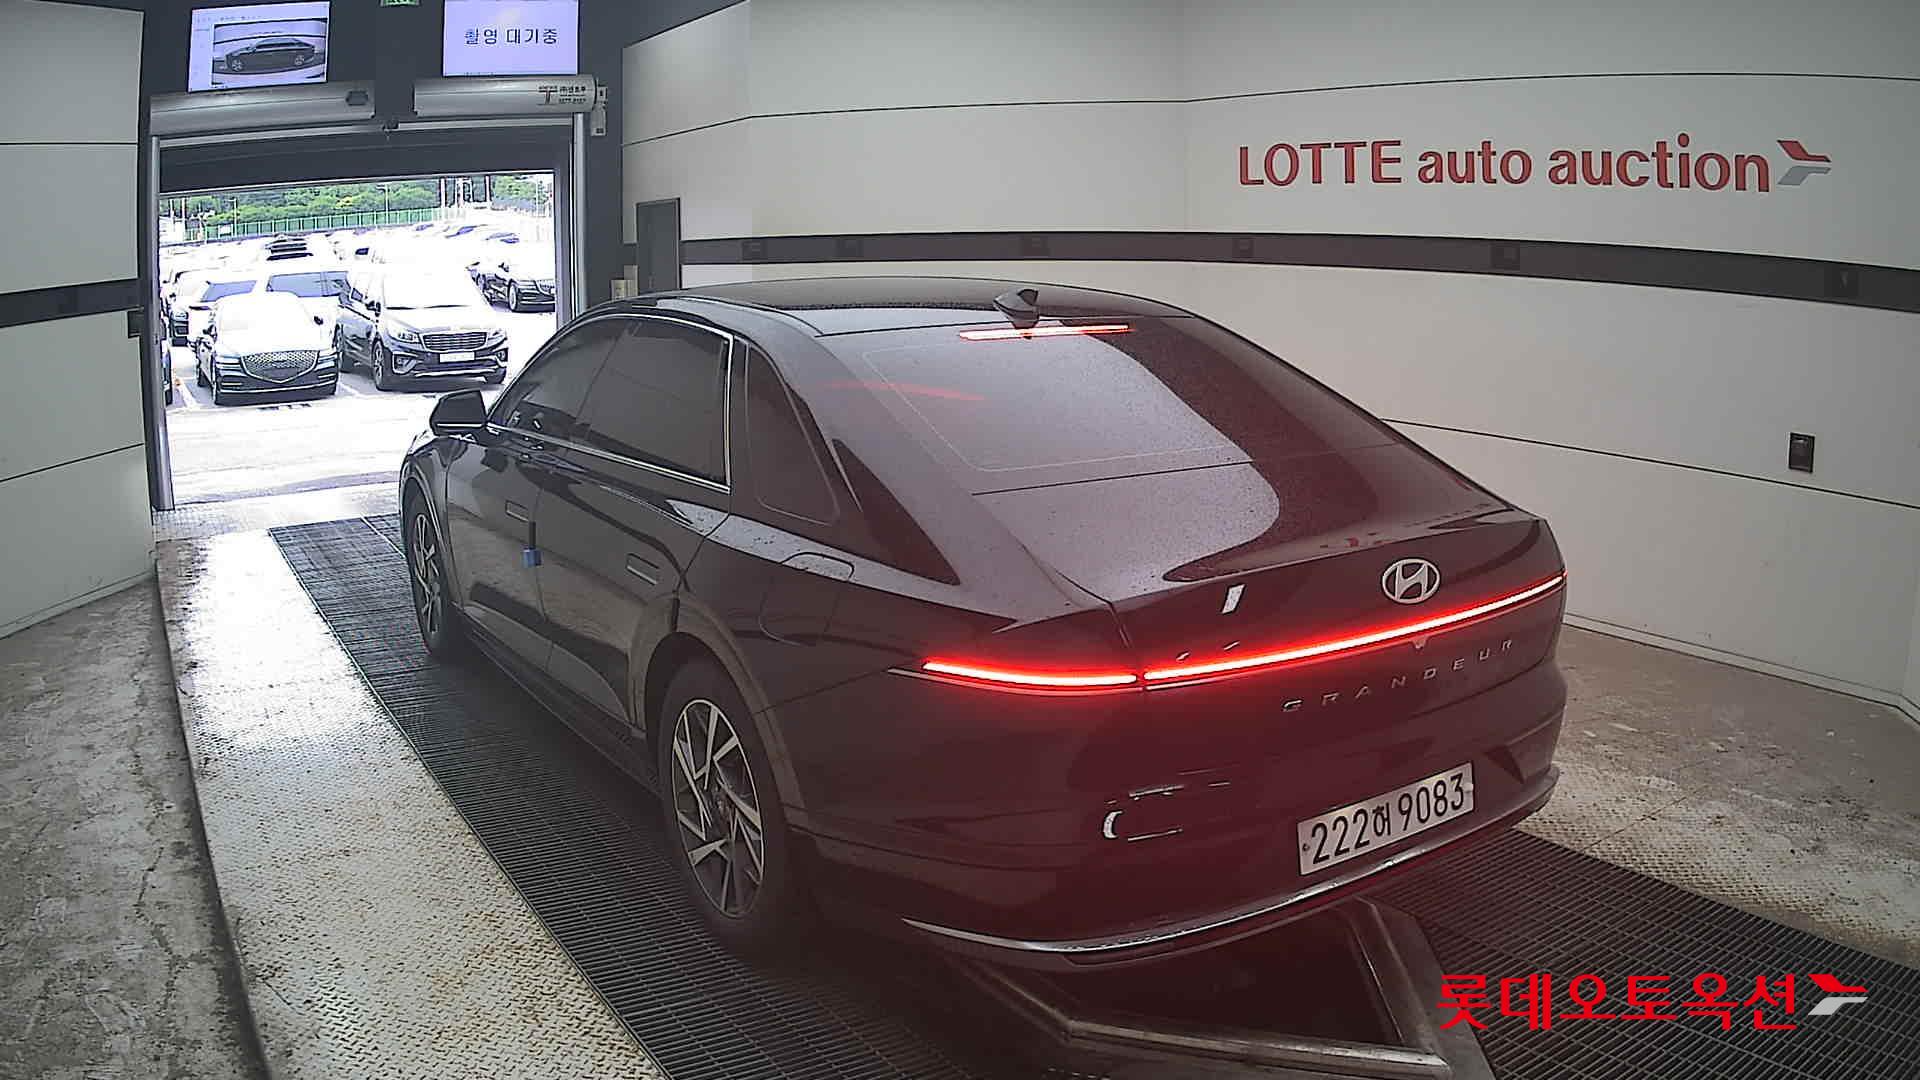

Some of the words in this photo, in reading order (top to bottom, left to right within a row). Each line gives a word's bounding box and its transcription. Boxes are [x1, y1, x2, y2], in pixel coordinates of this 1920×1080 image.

[464, 27, 498, 45] 촬영
[506, 28, 557, 45] 대기중
[1239, 140, 1401, 185] LOTTE
[1418, 140, 1533, 185] auto
[1549, 133, 1769, 192] auction
[1282, 639, 1512, 712] GRANDEUR
